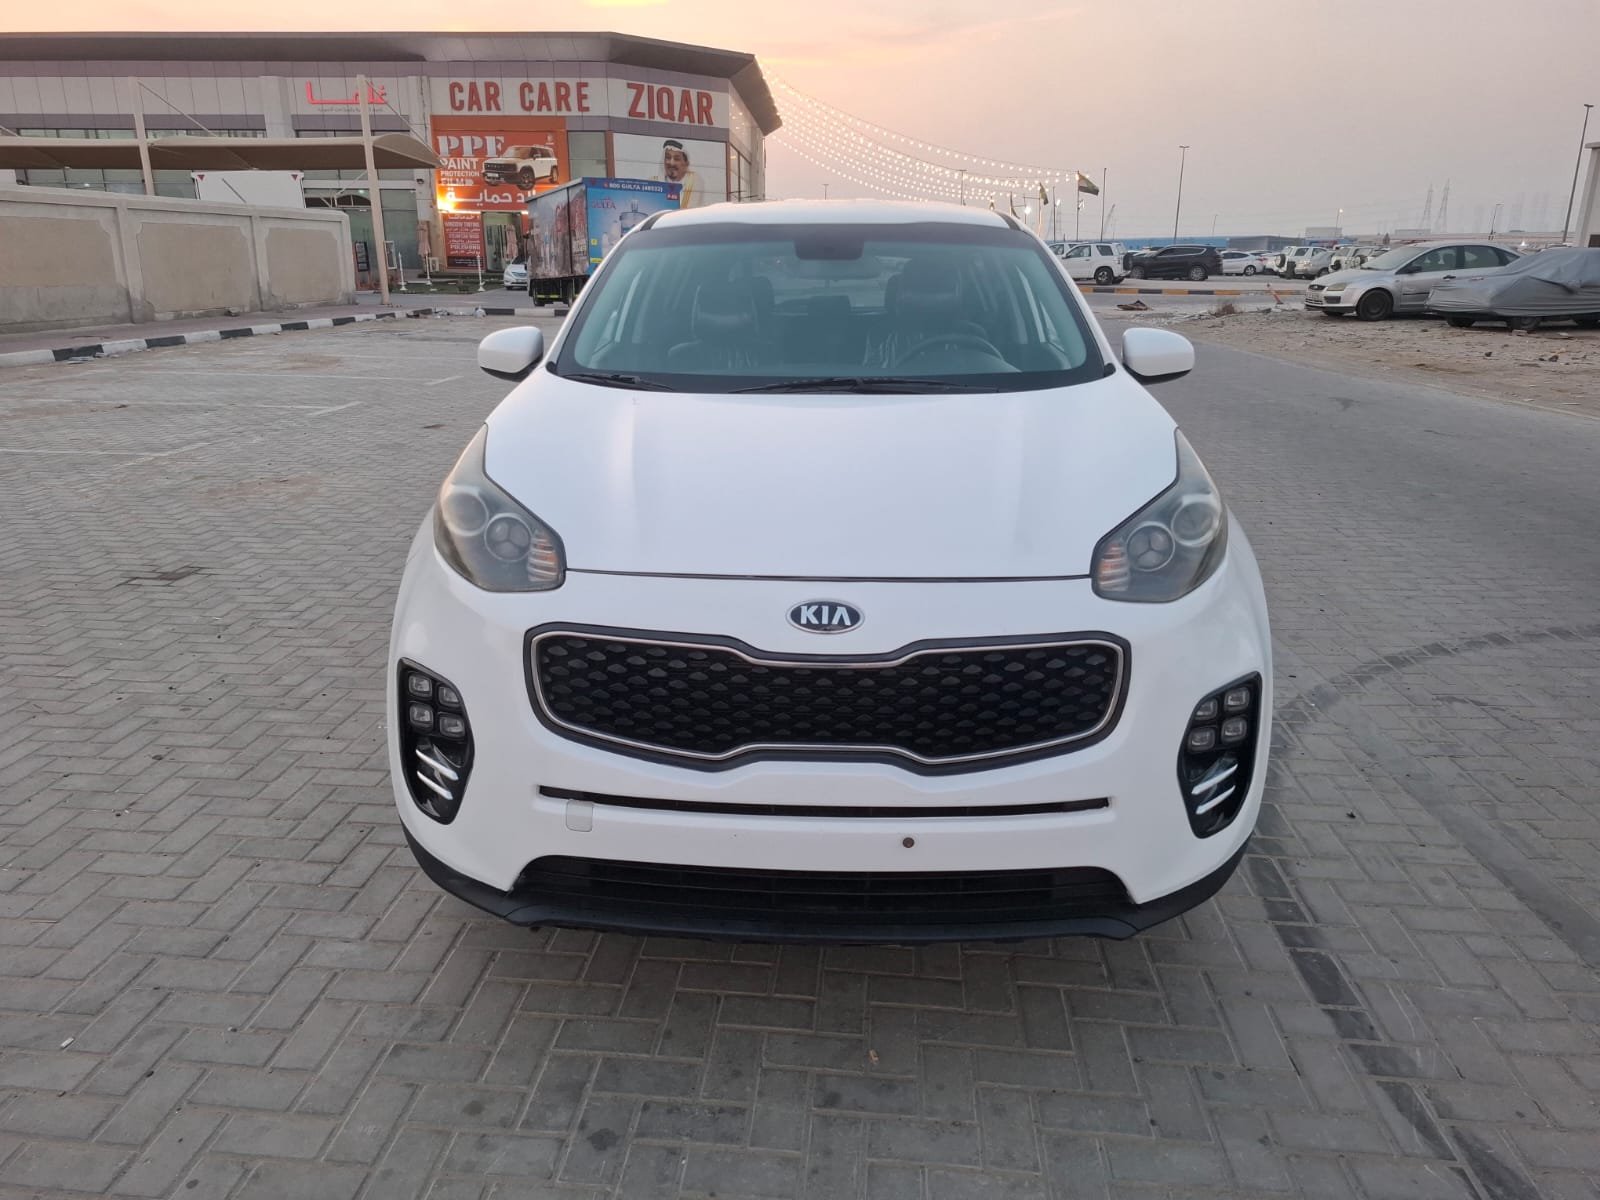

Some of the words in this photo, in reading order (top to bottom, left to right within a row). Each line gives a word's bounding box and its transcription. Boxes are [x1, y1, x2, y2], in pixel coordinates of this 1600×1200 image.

[449, 81, 501, 112] CAR
[519, 81, 590, 112] CARE
[626, 82, 714, 126] ZIQAR
[437, 135, 504, 157] PPF
[800, 605, 851, 626] KIA
